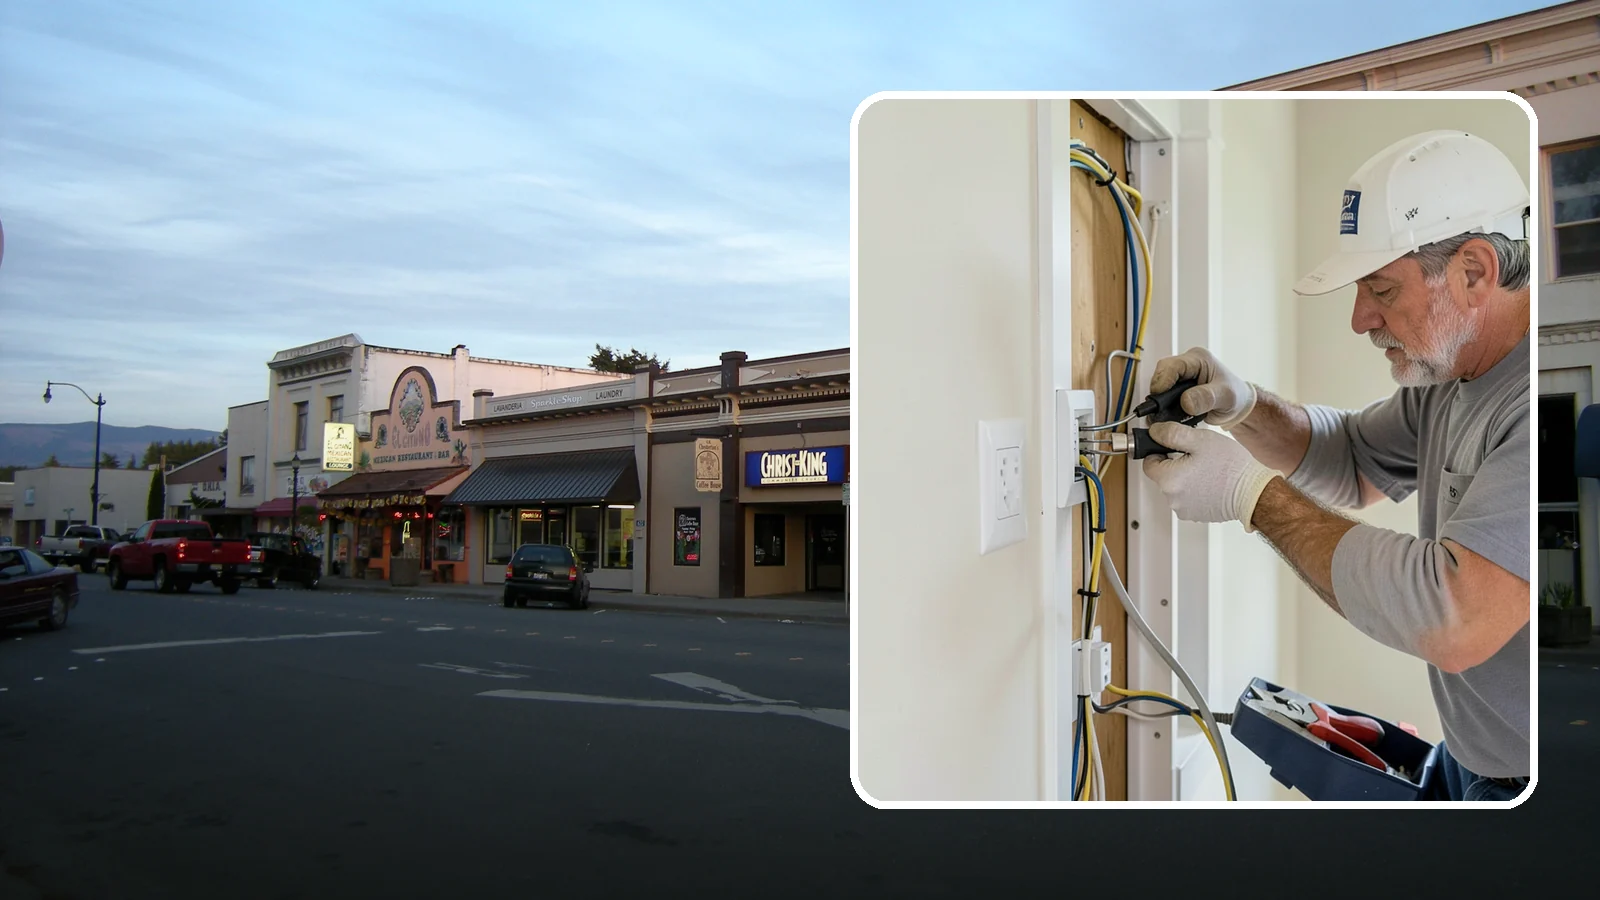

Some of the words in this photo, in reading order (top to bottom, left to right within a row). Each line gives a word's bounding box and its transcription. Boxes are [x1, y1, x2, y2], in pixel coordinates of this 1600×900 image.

[561, 394, 583, 405] Shop
[595, 388, 623, 400] LAUNDRY
[493, 402, 522, 413] LAVANDERIA
[373, 455, 396, 464] MEXICAN
[397, 451, 433, 463] RESTAURANT
[438, 449, 450, 459] BAR
[761, 452, 798, 478] CHRIST
[799, 449, 827, 476] KING
